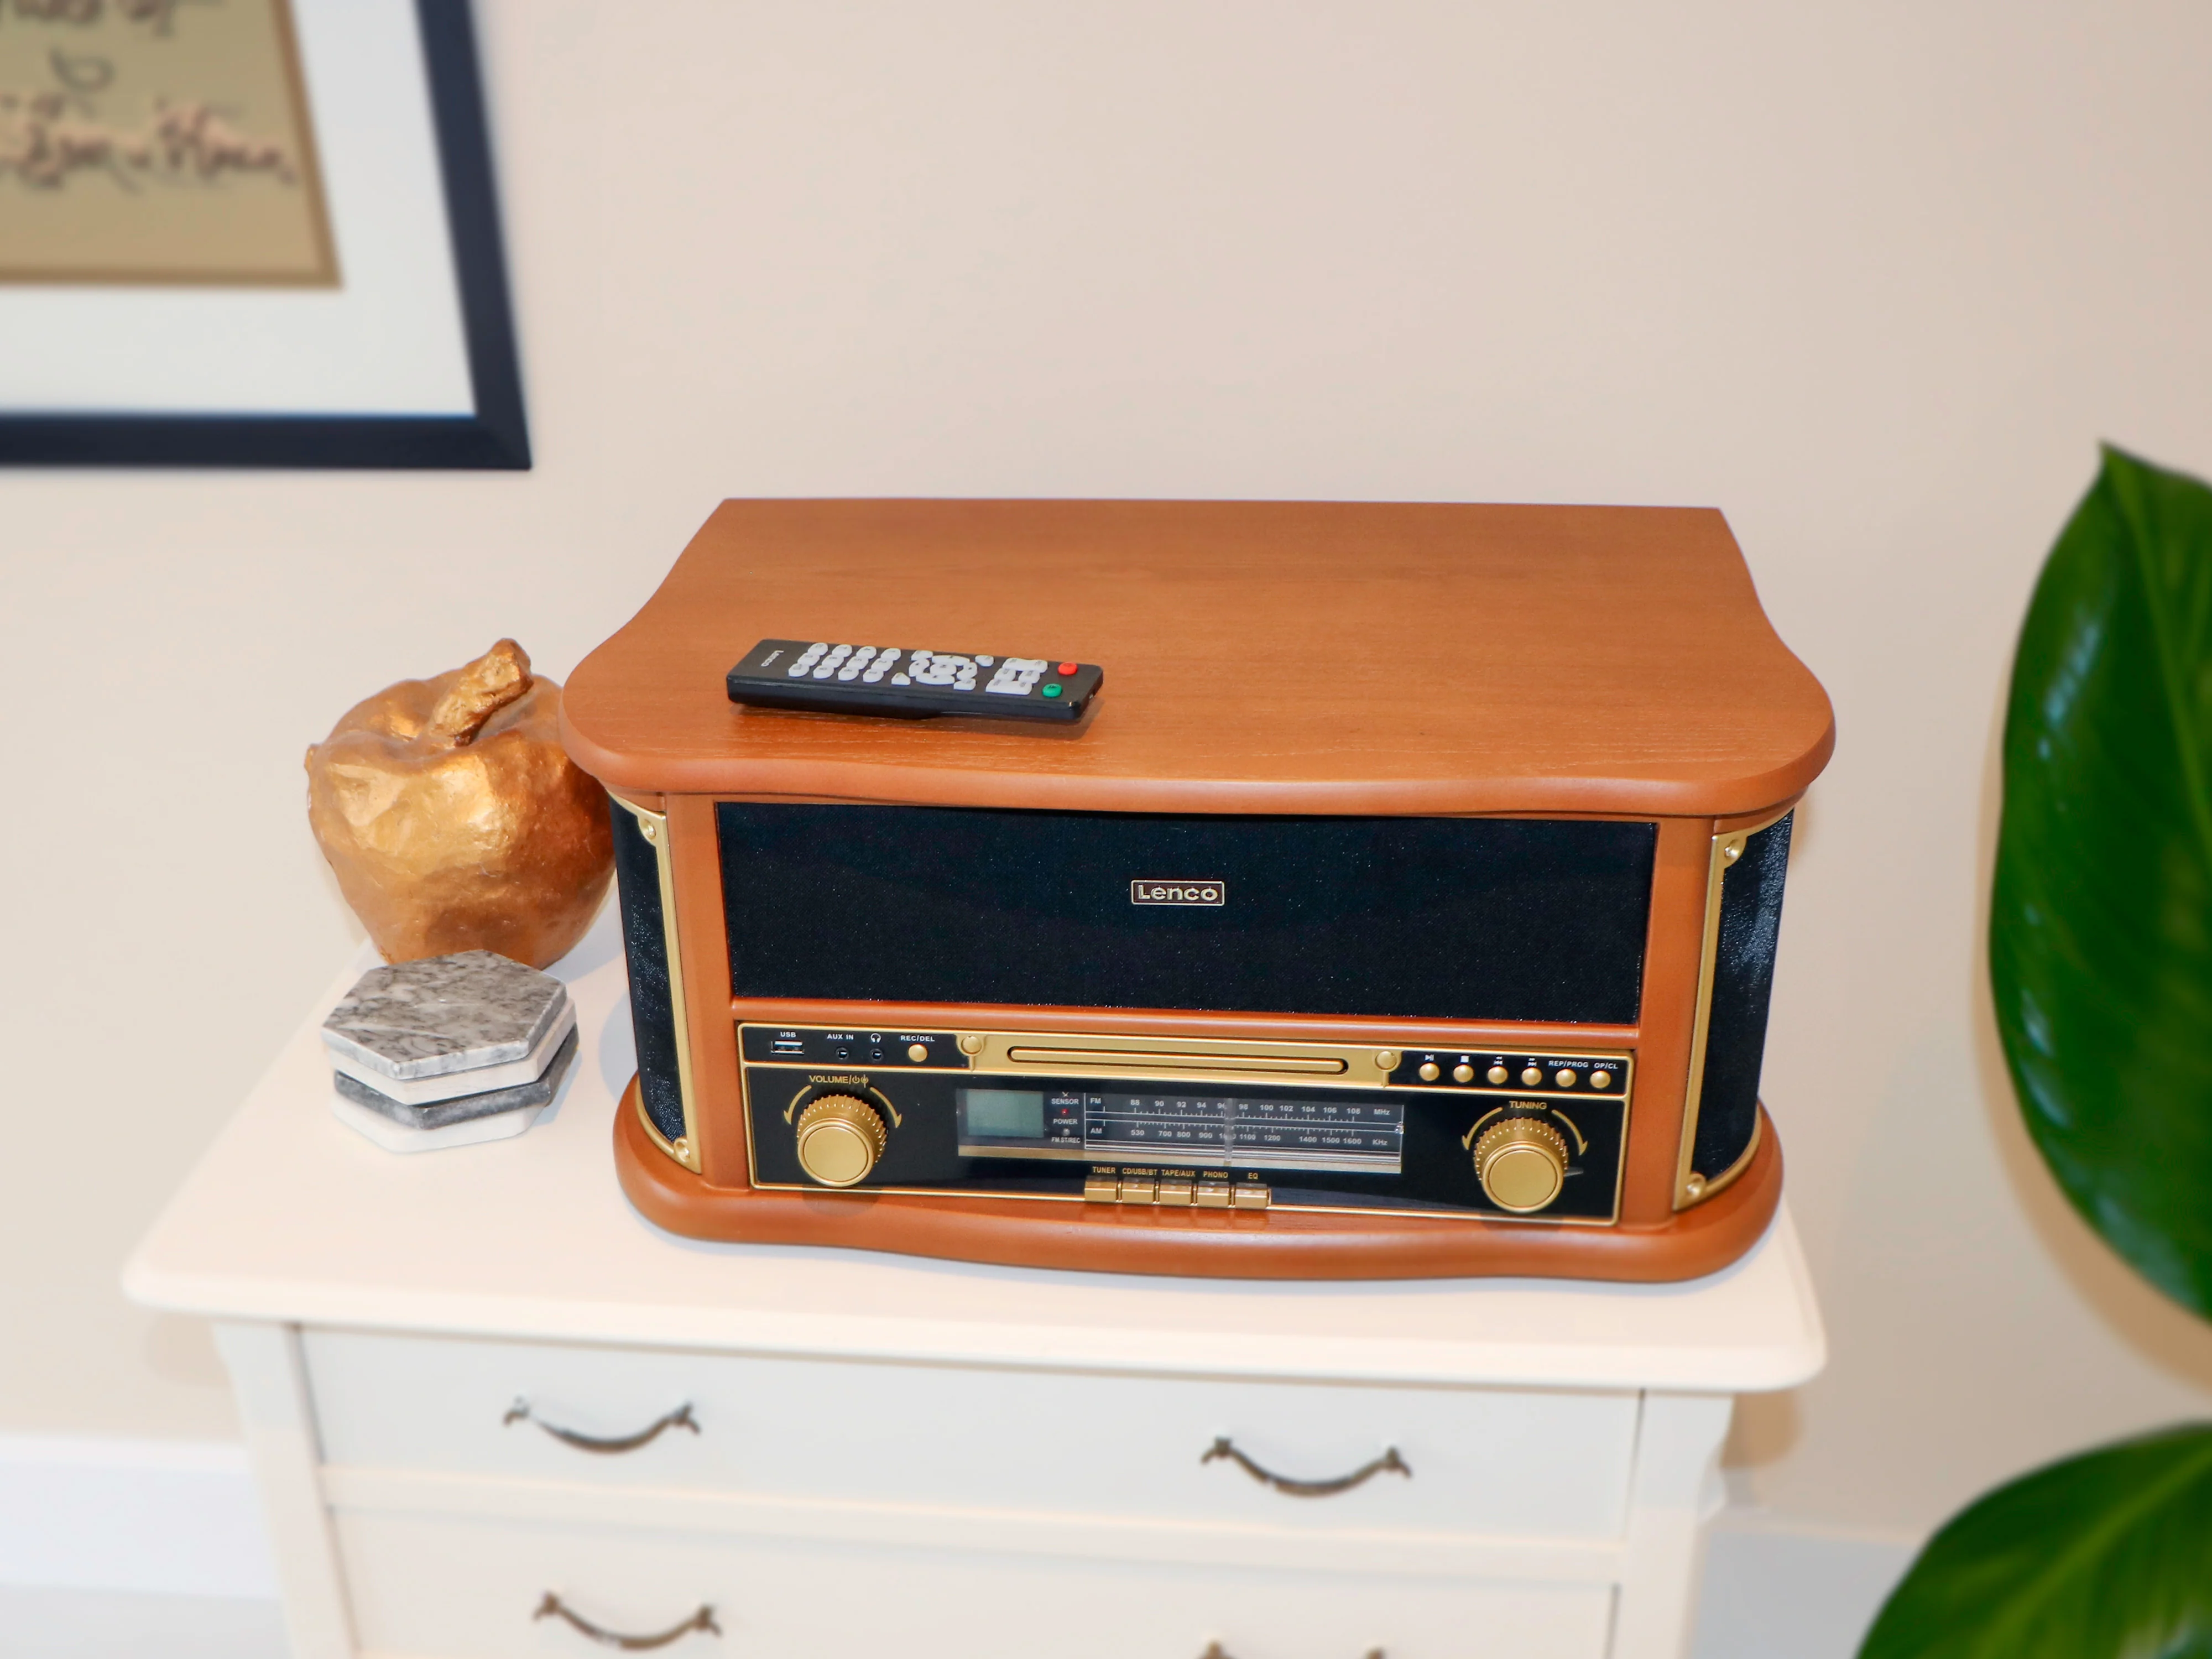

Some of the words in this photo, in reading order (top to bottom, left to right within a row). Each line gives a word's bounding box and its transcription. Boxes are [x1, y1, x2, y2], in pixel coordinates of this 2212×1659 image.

[1138, 885, 1218, 901] Lenco
[1548, 1060, 1589, 1068] REP/PROG
[1509, 1100, 1547, 1109] TUNING
